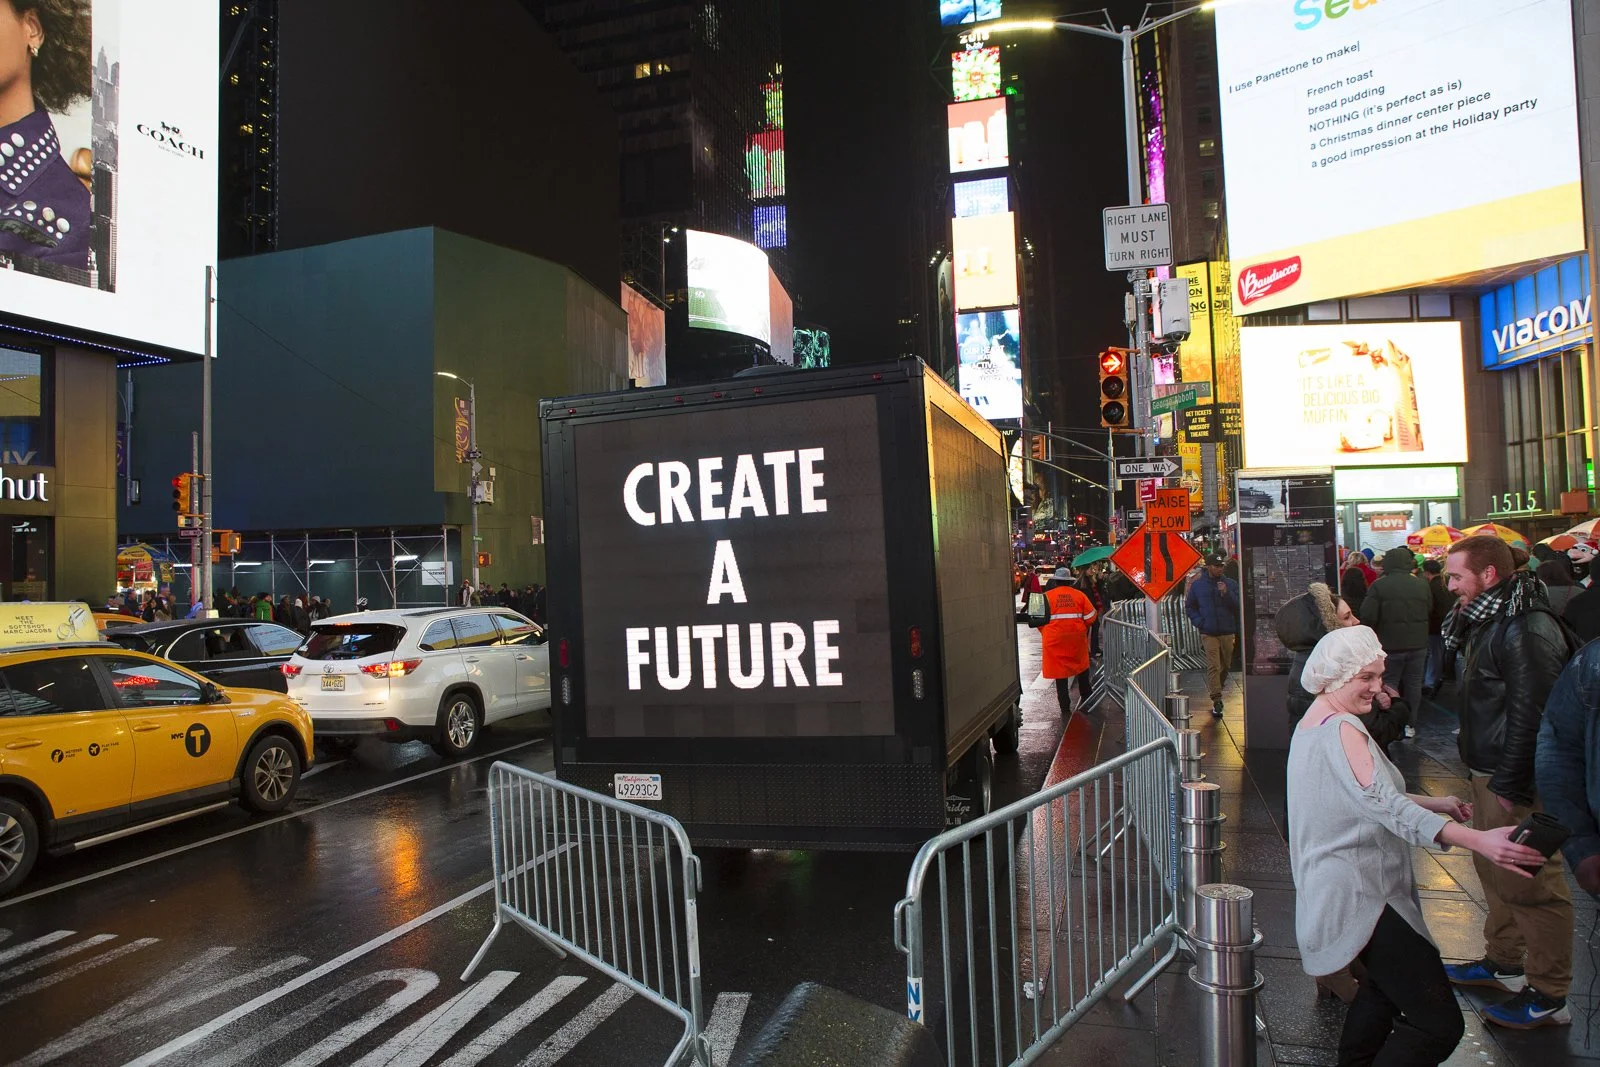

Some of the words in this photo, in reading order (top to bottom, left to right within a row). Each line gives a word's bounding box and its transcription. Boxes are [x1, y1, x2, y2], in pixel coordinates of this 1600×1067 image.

[1235, 80, 1253, 92] use
[1255, 61, 1309, 85] Panettone
[1312, 55, 1323, 65] to
[1307, 80, 1343, 98] French
[1346, 69, 1374, 85] toast
[1308, 99, 1337, 116] bread
[1340, 85, 1385, 108] pudding
[1309, 110, 1360, 133] NOTHING
[1362, 104, 1383, 119] (it's
[1386, 90, 1427, 112] perfect
[1429, 86, 1444, 97] as
[1447, 79, 1463, 91] is)
[1310, 142, 1316, 150] a
[1319, 126, 1373, 148] Christmas
[1376, 114, 1413, 132] dinner
[1416, 102, 1454, 120] center
[1457, 91, 1491, 110] piece
[1311, 160, 1317, 168] a
[1320, 151, 1347, 168] good
[1350, 134, 1412, 158] impression
[1415, 129, 1426, 140] at
[1430, 123, 1448, 136] the
[1452, 109, 1500, 129] Holiday
[1503, 98, 1538, 117] party
[136, 123, 204, 160] COACH
[1107, 214, 1137, 226] RIGHT
[1142, 211, 1167, 222] LANE
[1120, 230, 1155, 244] MUST
[1108, 251, 1135, 262] TURN
[1140, 247, 1170, 260] RIGHT
[1201, 383, 1209, 391] St
[1125, 464, 1145, 473] ONE
[1152, 462, 1172, 473] WAY
[0, 467, 49, 501] hut
[623, 447, 828, 526] CREATE
[1491, 490, 1537, 513] 1515
[1152, 516, 1185, 528] PLOW
[707, 539, 748, 605] A
[625, 619, 843, 690] FUTURE
[171, 732, 184, 740] NYC
[190, 729, 205, 753] T
[618, 783, 659, 796] 49293C2
